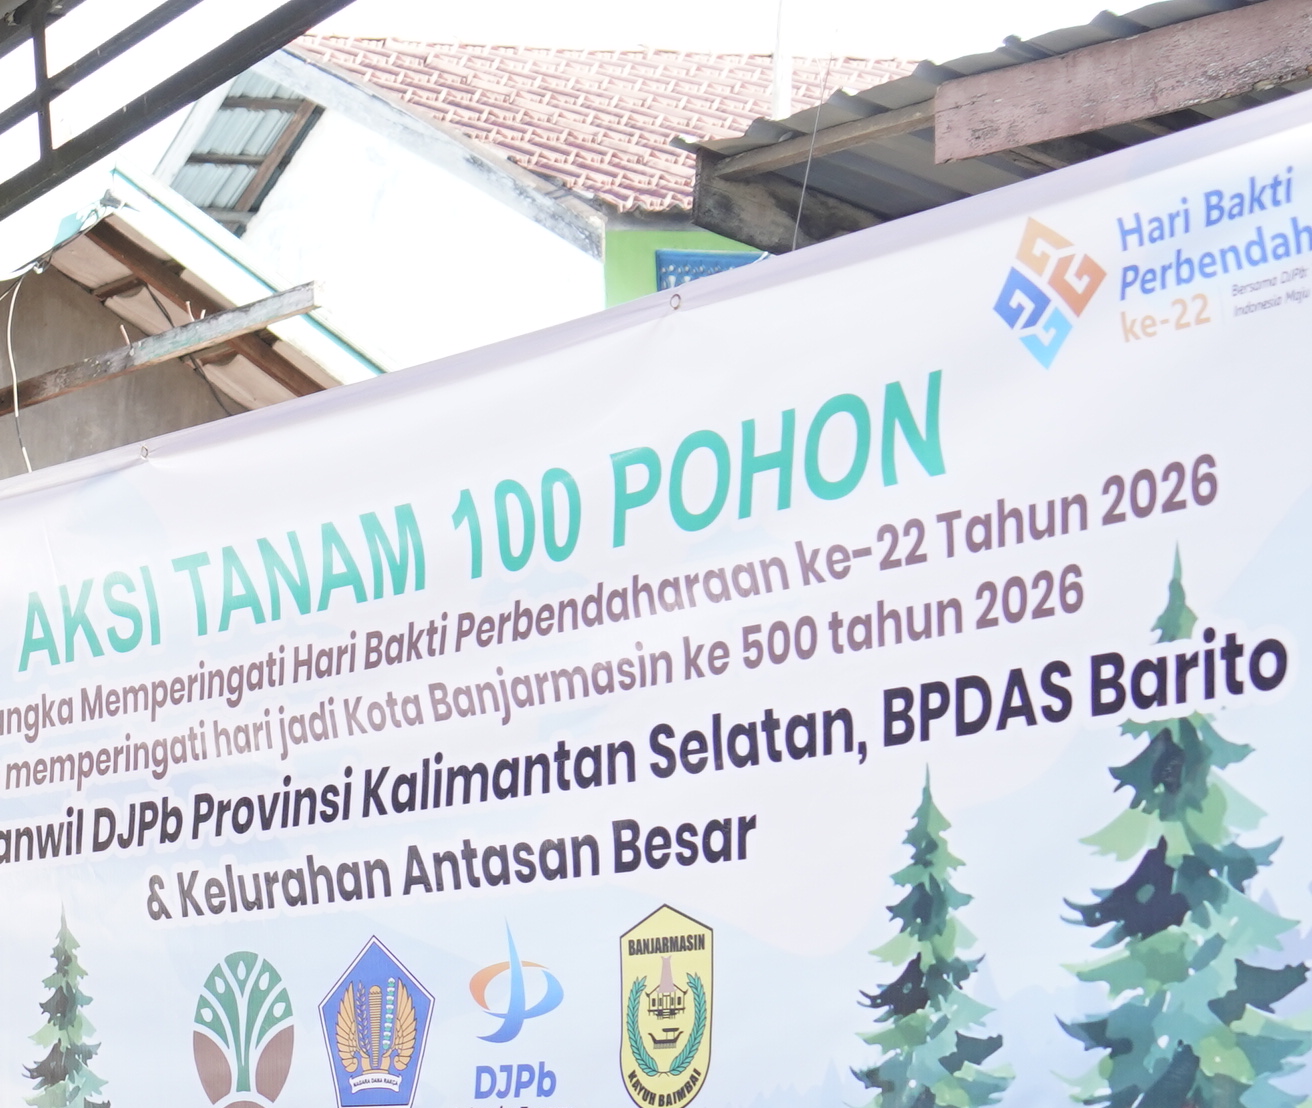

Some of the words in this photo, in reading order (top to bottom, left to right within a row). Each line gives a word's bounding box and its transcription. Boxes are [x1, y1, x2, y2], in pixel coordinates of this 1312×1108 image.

[1117, 197, 1190, 251] Hari
[1204, 166, 1293, 227] Bakti
[1121, 293, 1211, 342] ke-22
[18, 565, 161, 672] AKSI
[172, 503, 425, 637] TANAM
[451, 467, 581, 579] 100
[610, 369, 946, 548] POHON
[80, 645, 285, 711] Memperingati
[292, 631, 357, 686] Hari
[364, 612, 448, 670] Bakti
[455, 554, 790, 652] Perbendaharaan
[795, 517, 927, 586] ke-22
[936, 491, 1088, 558] Tahun
[1101, 453, 1218, 526] 2026
[4, 721, 208, 791] memperingati
[214, 708, 273, 752] hari
[279, 697, 338, 760] jadi
[344, 690, 423, 738] Kota
[429, 641, 673, 725] Banjarmasin
[683, 635, 730, 681] ke
[742, 615, 818, 670] 500
[829, 595, 963, 654] tahun
[975, 564, 1084, 630] 2026
[92, 797, 183, 853] DJPb
[191, 766, 352, 841] Provinsi
[362, 739, 636, 818] Kalimantan
[649, 707, 868, 779] Selatan,
[883, 660, 1072, 747] BPDAS
[1090, 627, 1287, 717] Barito
[147, 874, 173, 920] &
[178, 854, 392, 918] Kelurahan
[403, 834, 600, 896] Antasan
[612, 814, 757, 874] Besar
[628, 934, 705, 956] BANJARMASIN
[474, 1061, 557, 1099] DJPb
[628, 1070, 655, 1106] KAYUH
[658, 1068, 702, 1107] BAIMBAI
